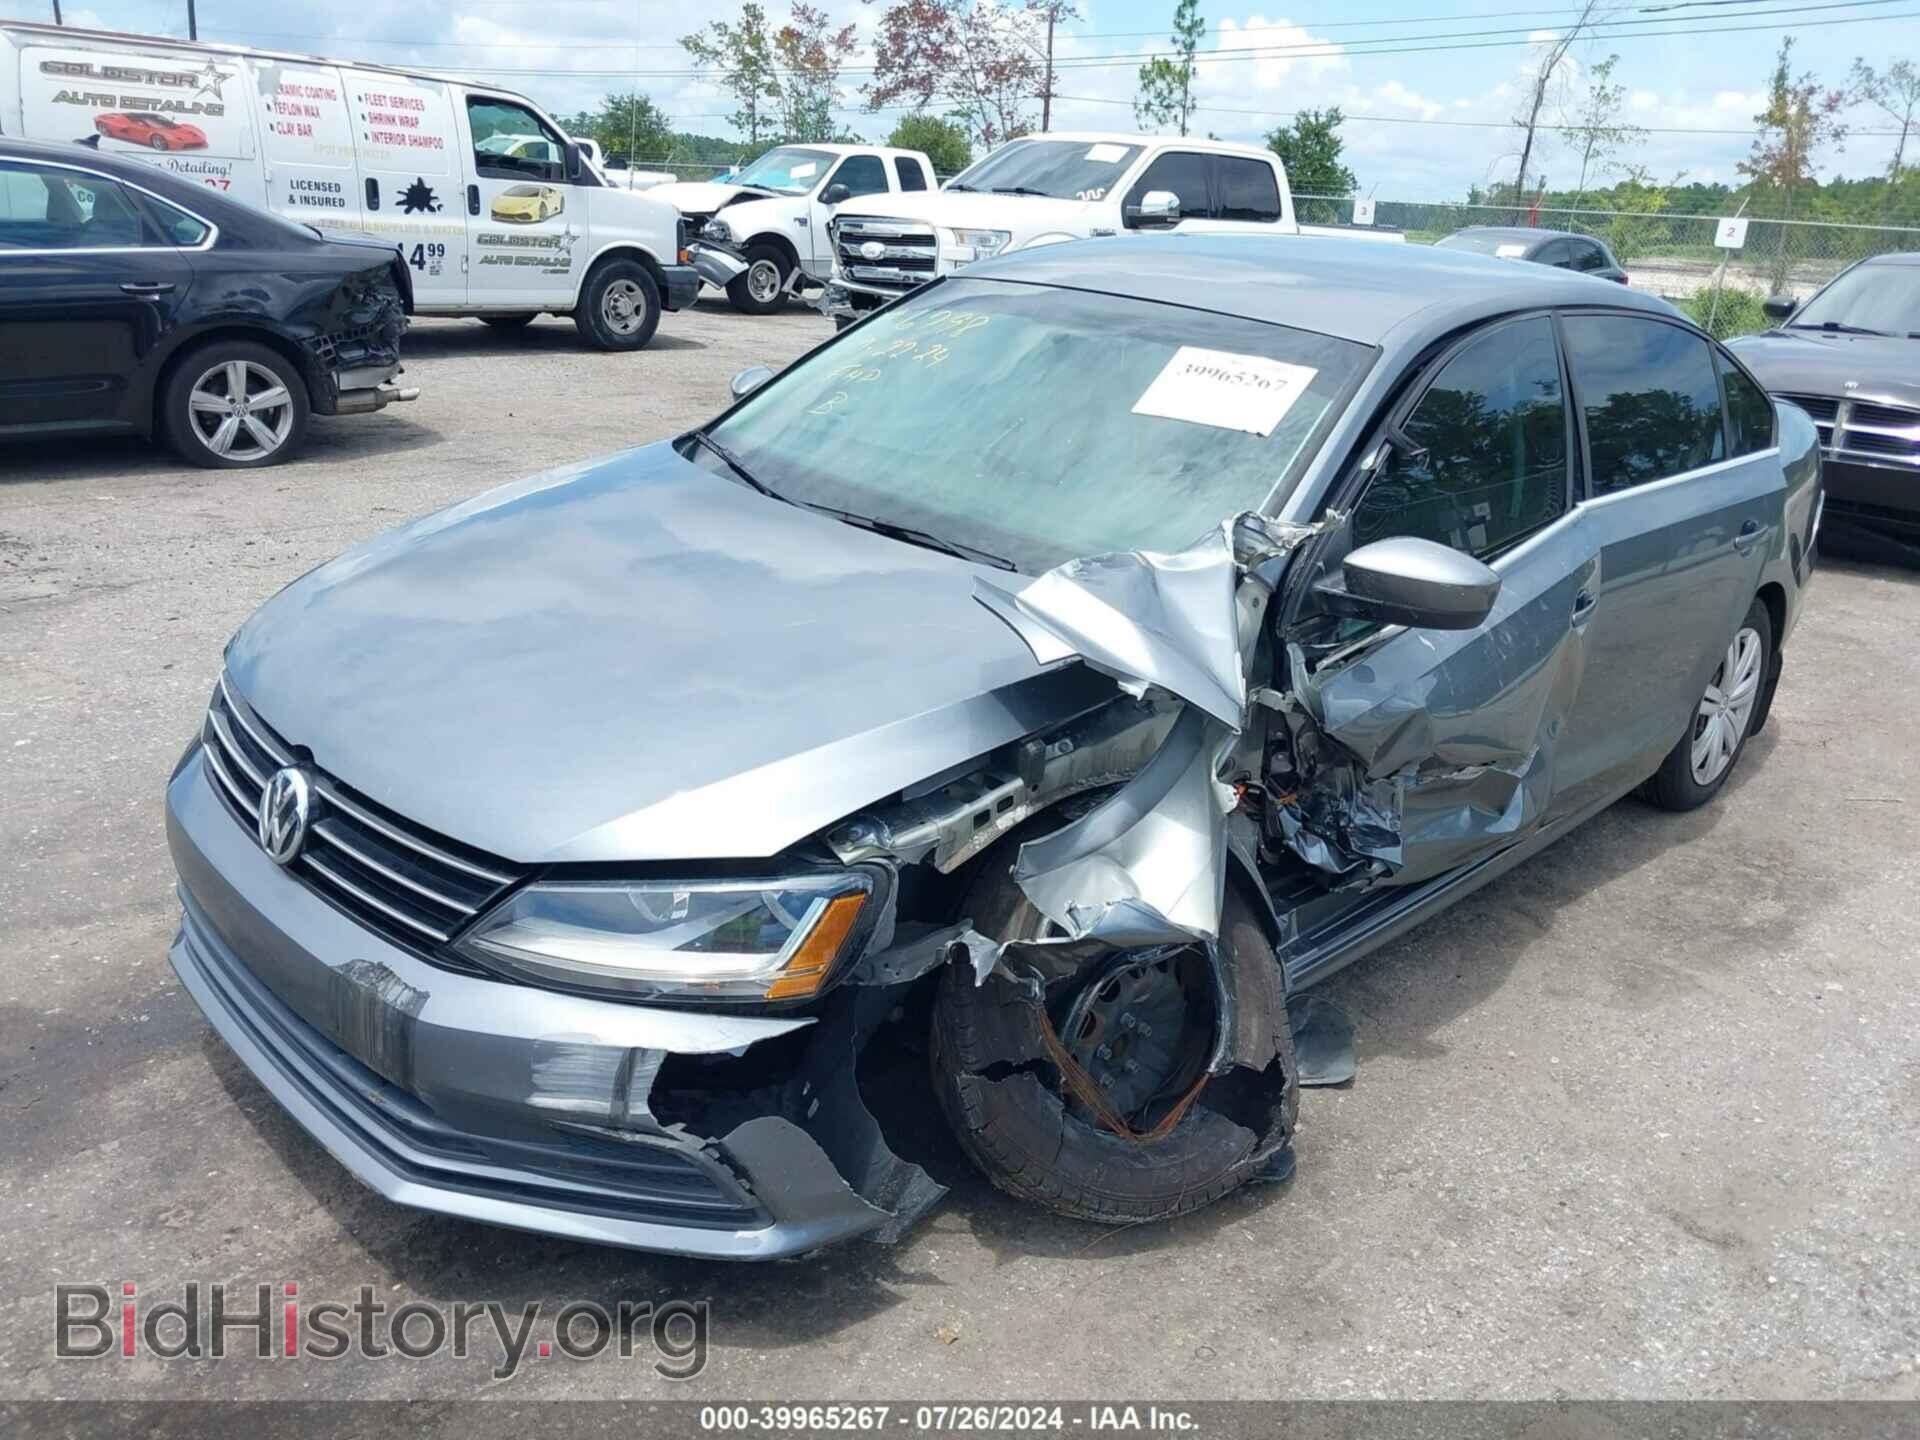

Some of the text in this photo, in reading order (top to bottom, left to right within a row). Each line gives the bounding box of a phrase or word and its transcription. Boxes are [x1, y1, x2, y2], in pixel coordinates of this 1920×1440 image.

[40, 61, 200, 88] GOLDSTAR
[304, 86, 336, 101] COATING
[365, 93, 424, 111] FLEET SERVICES
[52, 90, 224, 116] AUTO DETAILING
[273, 102, 320, 119] TEFLON WAX
[368, 112, 419, 129] SHRINK WRAP
[277, 122, 313, 137] CLAY BAR
[371, 132, 443, 150] INTERIOR SHAMPOO
[290, 180, 341, 193] LICENSED
[288, 194, 345, 208] & INSURED
[1727, 227, 1736, 238] 2
[1178, 363, 1289, 391] 39965267
